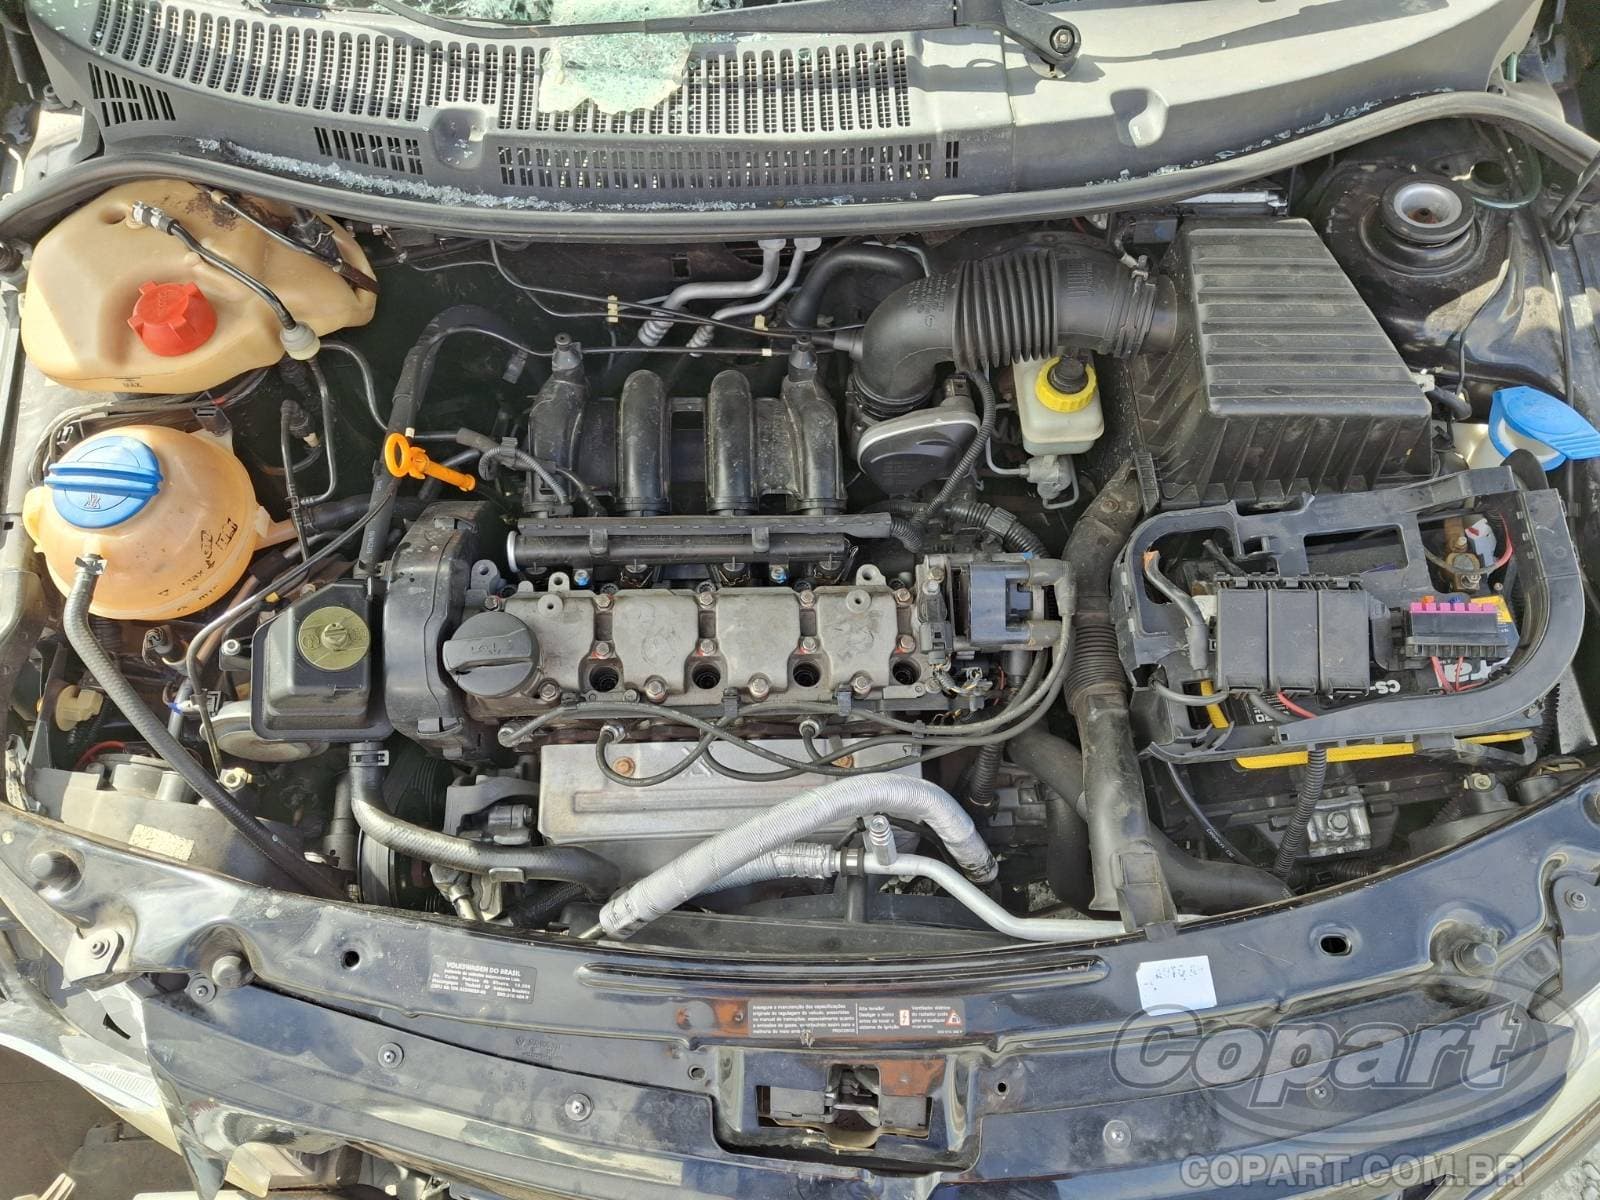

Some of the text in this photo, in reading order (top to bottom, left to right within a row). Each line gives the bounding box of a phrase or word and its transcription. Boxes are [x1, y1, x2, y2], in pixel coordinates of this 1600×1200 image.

[446, 961, 521, 977] VOLKSWAGEN DO BRASIL
